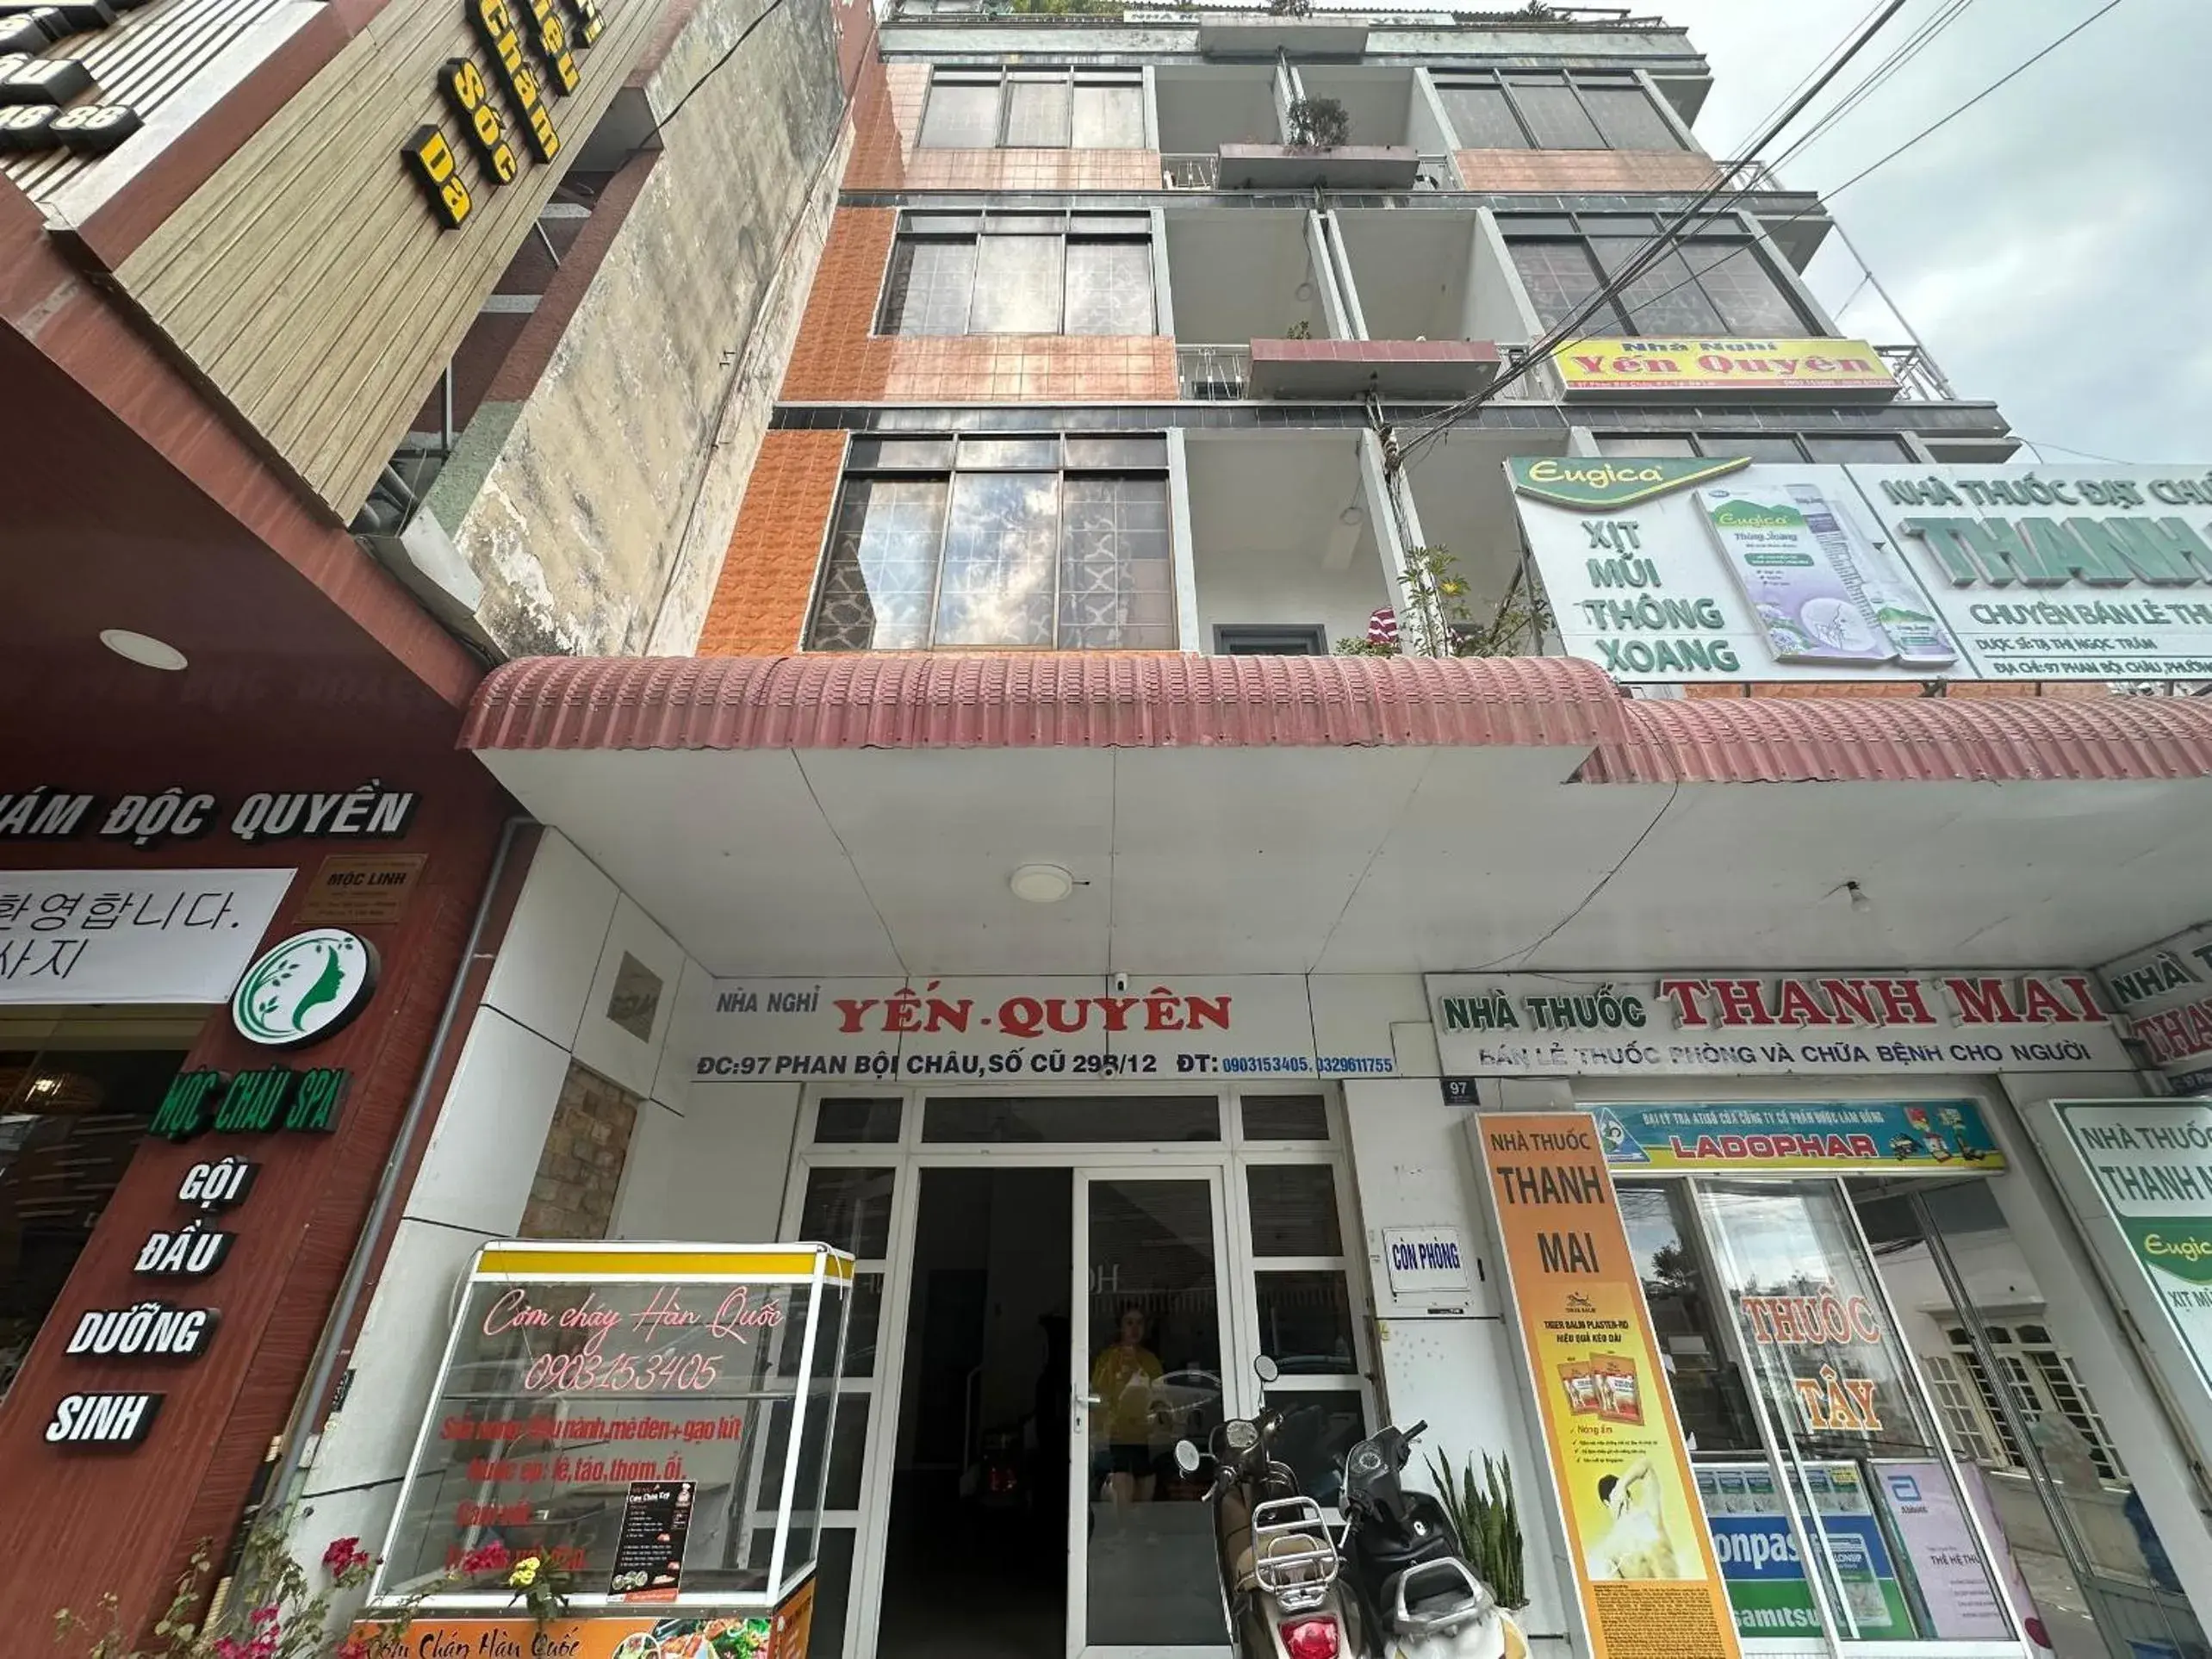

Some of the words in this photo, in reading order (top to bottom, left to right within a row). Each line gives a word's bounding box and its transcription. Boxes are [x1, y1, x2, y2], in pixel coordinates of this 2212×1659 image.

[419, 131, 472, 224] Da
[1571, 354, 1681, 373] Yến
[1697, 354, 1876, 375] Quyên
[1529, 461, 1663, 488] Eugica
[1880, 475, 1962, 506] NHÀ
[1581, 519, 1640, 552] XỊT
[1581, 593, 1724, 630] THÔNG
[1594, 637, 1741, 674] XOANG
[0, 784, 93, 835] ÁM
[100, 787, 215, 846] ĐỘC
[230, 779, 414, 839] QUYỀN
[367, 872, 407, 886] LINH
[2110, 951, 2192, 1006] NHÀ
[832, 980, 974, 1033] YẾN
[997, 985, 1232, 1038] QUYÊN
[1442, 988, 1520, 1030] NHÀ
[1523, 982, 1648, 1029] THUỐC
[1660, 978, 1937, 1029] THANH
[1944, 977, 2112, 1027] MAI
[774, 1054, 847, 1075] PHAN
[854, 1050, 899, 1080] BỘI
[1760, 1041, 1795, 1063] VÀ
[1800, 1041, 1871, 1063] CHỮA
[1875, 1041, 1945, 1066] BỆNH
[1949, 1044, 2004, 1061] CHO
[2010, 1039, 2091, 1061] NGƯỜI
[286, 1070, 345, 1133] SPA
[1450, 1082, 1467, 1095] 97
[1489, 1130, 1529, 1152] NHÀ
[1529, 1127, 1592, 1152] THUỐC
[1669, 1134, 1881, 1159] LADOPHAR
[2079, 1123, 2138, 1151] NHÀ
[2139, 1120, 2212, 1151] THUỐ
[179, 1157, 250, 1209] GỘI
[1496, 1165, 1606, 1204] THANH
[2099, 1165, 2204, 1202] THANH
[134, 1219, 224, 1272] ĐẦU
[1419, 1235, 1461, 1270] PHÒNG
[1537, 1232, 1600, 1274] MAI
[65, 1303, 207, 1354] DƯỠNG
[630, 1285, 702, 1344] Hàn
[705, 1284, 786, 1345] Quốc
[1793, 1363, 1884, 1432] TÂY
[46, 1395, 149, 1442] SINH
